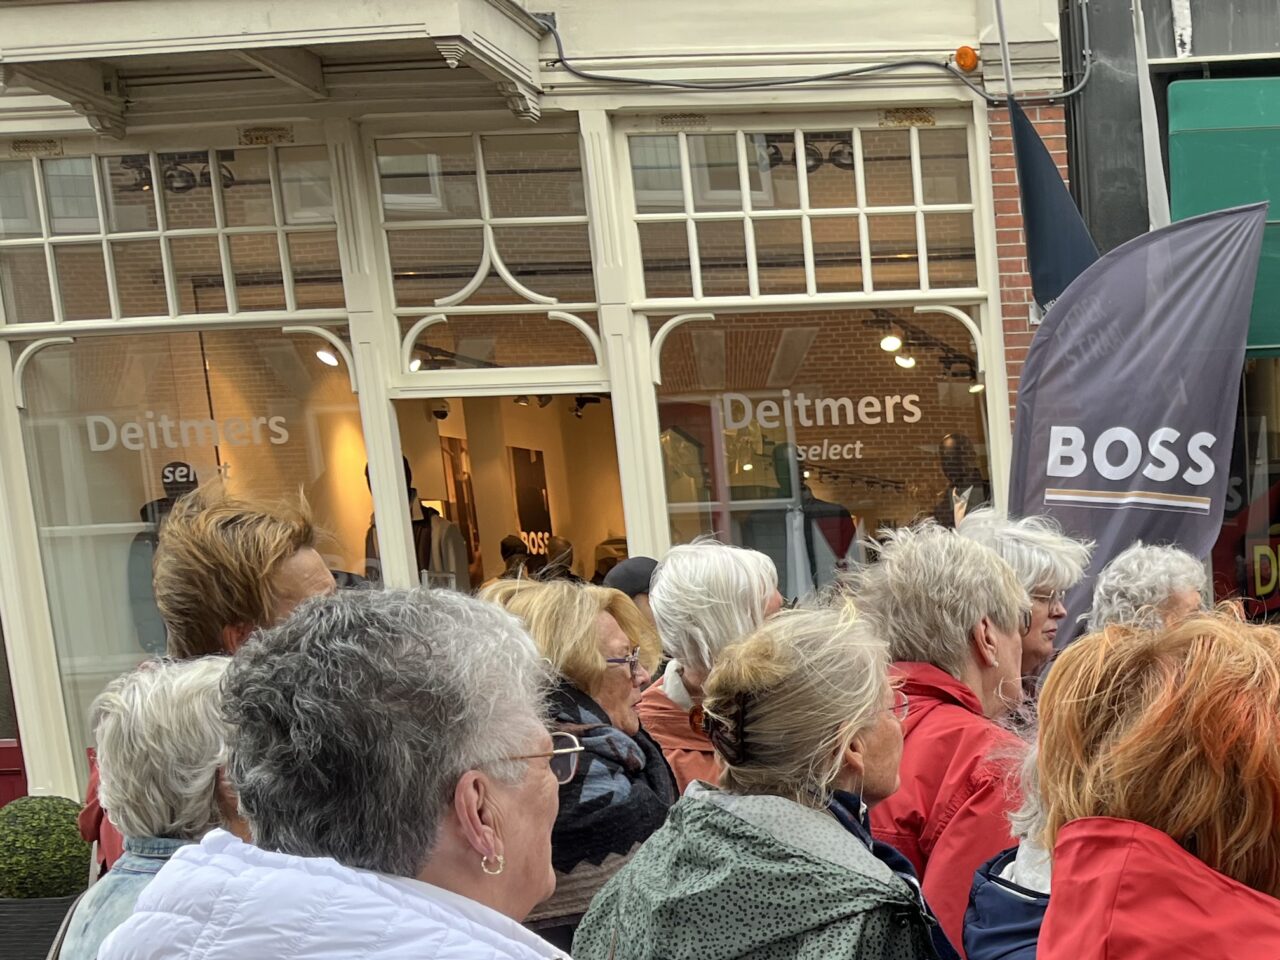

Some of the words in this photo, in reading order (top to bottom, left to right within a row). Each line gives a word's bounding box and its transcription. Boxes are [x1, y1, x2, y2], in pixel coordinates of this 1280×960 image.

[722, 389, 922, 430] Deitmers
[86, 411, 289, 451] Deitmers
[796, 438, 864, 461] select
[163, 461, 231, 483] selt
[1046, 426, 1217, 486] BOSS
